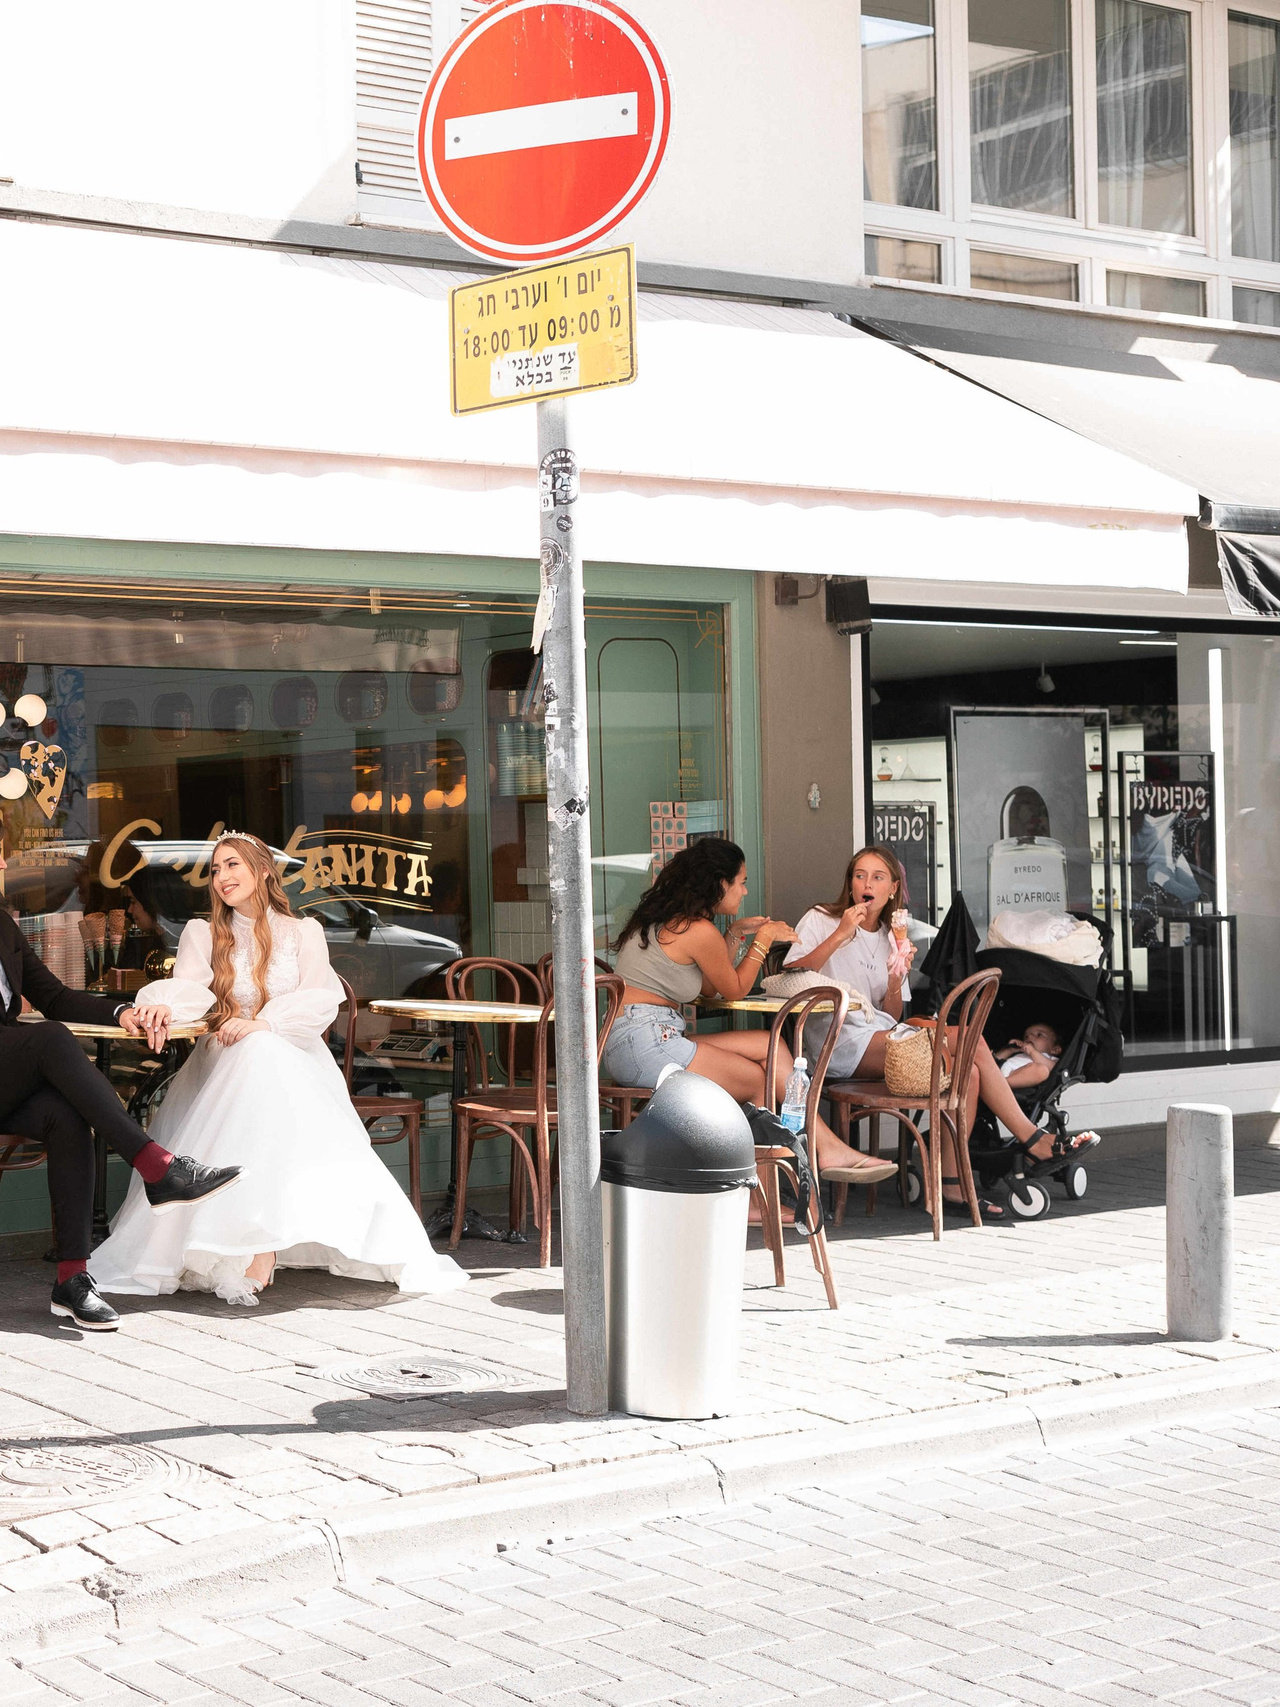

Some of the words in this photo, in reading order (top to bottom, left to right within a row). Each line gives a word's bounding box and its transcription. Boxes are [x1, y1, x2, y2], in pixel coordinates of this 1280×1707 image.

[577, 268, 601, 295] יום
[478, 293, 496, 318] חג
[505, 281, 548, 311] וערבי
[518, 322, 538, 348] עד
[547, 309, 600, 342] 09:00
[463, 328, 510, 360] 18:00
[515, 371, 553, 388] בכלא
[1133, 786, 1206, 811] BYREDO
[873, 816, 924, 842] REDO
[300, 844, 433, 897] ANITA
[1014, 865, 1042, 874] BYREDO
[997, 895, 1011, 906] BAL
[1014, 891, 1061, 904] D'AFRIQUE
